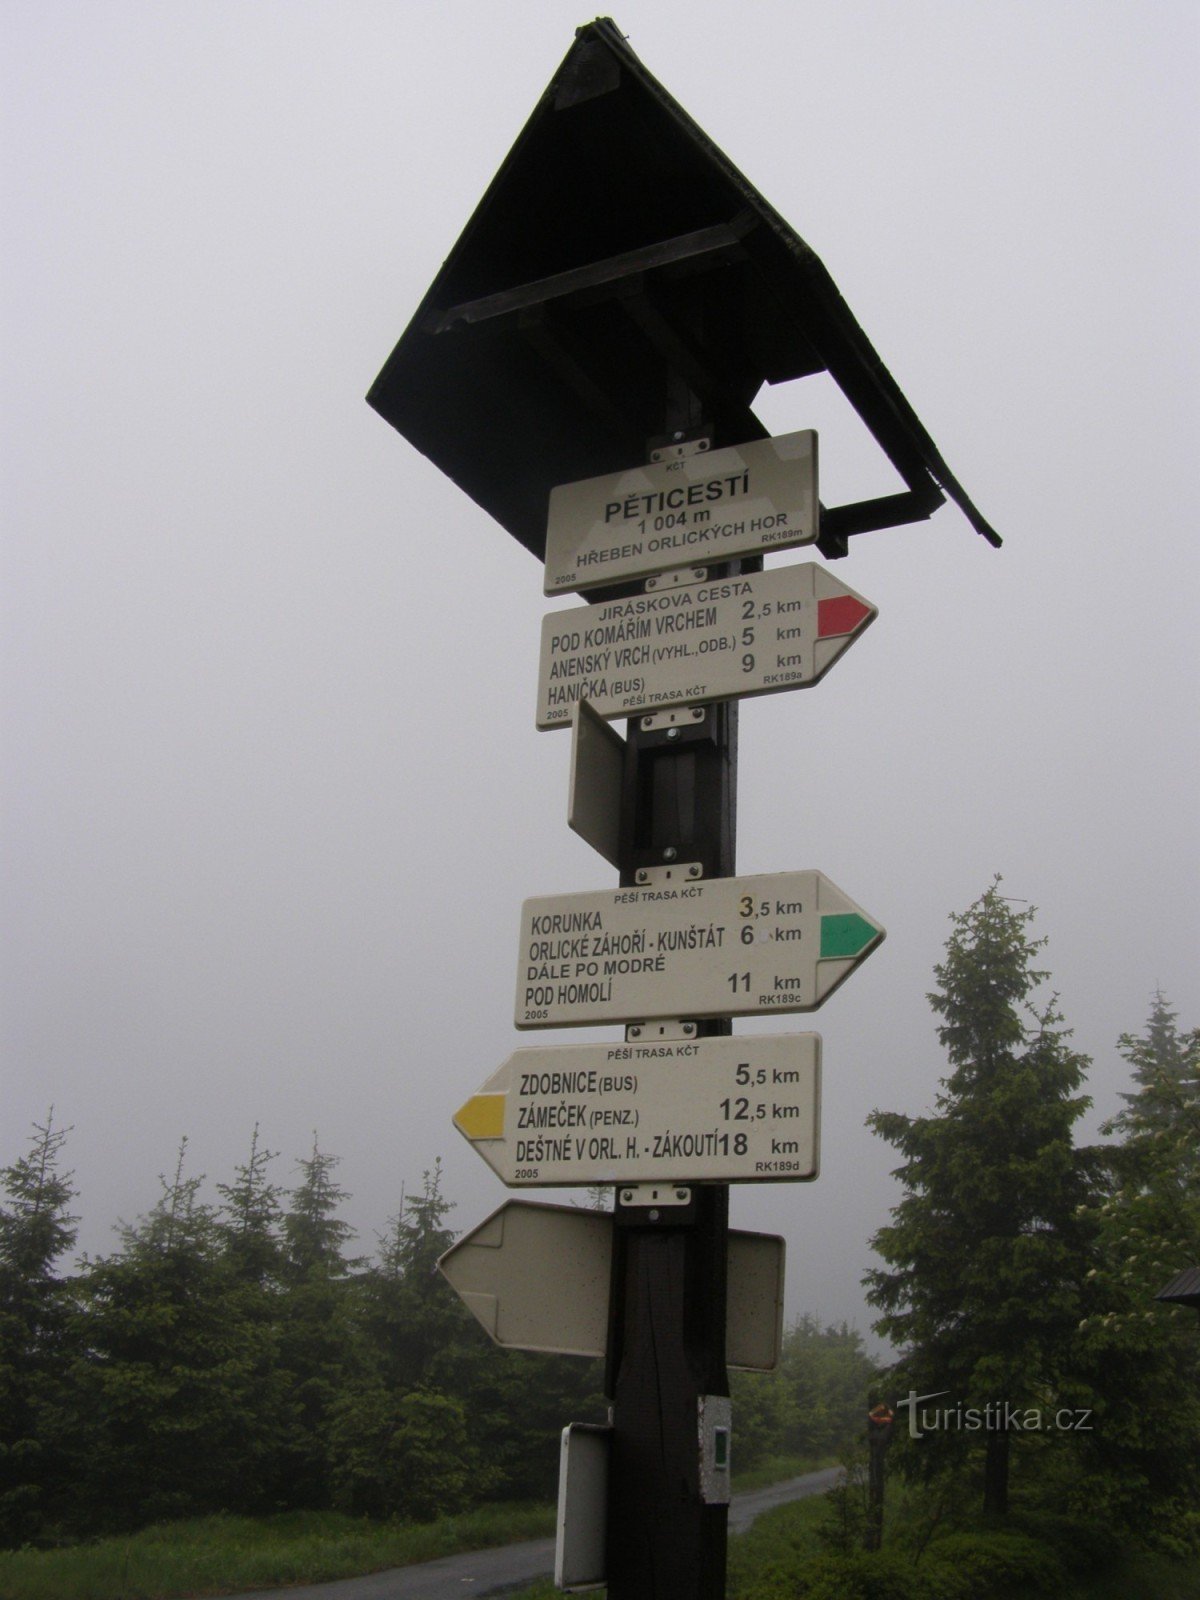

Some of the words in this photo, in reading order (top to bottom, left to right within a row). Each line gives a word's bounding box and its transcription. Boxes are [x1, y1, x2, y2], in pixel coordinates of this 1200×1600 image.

[666, 461, 686, 473] KČT
[604, 468, 750, 523] PĚTICESTÍ
[693, 509, 711, 524] m
[576, 542, 643, 568] HŘEBEN
[648, 521, 745, 552] ORLICKÝCH
[750, 513, 788, 533] HOR
[761, 529, 803, 544] RK189m
[555, 573, 577, 585] 2005
[598, 591, 693, 621] JIRÁSKOVA
[697, 581, 753, 602] CESTA
[551, 632, 580, 654] POD
[584, 615, 650, 649] KOMÁŘÍM
[655, 606, 718, 635] VRCHEM
[741, 600, 771, 620] 2,5
[777, 599, 801, 614] km
[549, 647, 611, 680] ANENSKÝ
[614, 645, 650, 669] VRCH
[741, 627, 755, 646] 5
[777, 626, 801, 641] km
[548, 677, 607, 706] HANIČKA
[610, 677, 645, 698] (BUS)
[742, 653, 755, 673] 9
[777, 653, 801, 668] km
[763, 671, 802, 685] RK189a
[649, 690, 682, 703] TRASA
[686, 685, 707, 697] KČT
[546, 708, 569, 720] 2005
[641, 890, 678, 902] TRASA
[681, 887, 704, 899] KČT
[531, 911, 602, 935] KORUNKA
[739, 896, 770, 920] 3,5
[775, 900, 802, 915] km
[529, 933, 589, 962] ORLICKÉ
[592, 929, 646, 957] ZÁHOŘÍ
[657, 923, 725, 952] KUNŠTÁT
[740, 925, 754, 945] 6
[775, 927, 802, 941] km
[527, 960, 571, 981] DÁLE
[575, 962, 599, 976] PO
[603, 953, 666, 975] MODRÉ
[525, 986, 553, 1007] POD
[557, 978, 612, 1005] HOMOLÍ
[727, 972, 752, 993] 11
[774, 976, 801, 990] km
[759, 993, 801, 1006] RK189c
[524, 1009, 549, 1020] 2005
[636, 1047, 673, 1059] TRASA
[676, 1044, 700, 1056] KČT
[519, 1070, 597, 1096] ZDOBNICE
[599, 1075, 639, 1096] (BUS)
[735, 1063, 766, 1087] 5,5
[772, 1069, 800, 1084] km
[517, 1101, 586, 1129] ZÁMEČEK
[589, 1109, 640, 1130] (PENZ.)
[719, 1097, 766, 1122] 12,5
[772, 1104, 800, 1119] km
[516, 1135, 571, 1162] DEŠTNÉ
[576, 1138, 586, 1160] V
[588, 1137, 622, 1160] ORL.
[625, 1137, 640, 1159] H.
[652, 1128, 719, 1158] ZÁKOUTÍ
[719, 1133, 749, 1156] 18
[771, 1138, 799, 1153] km
[515, 1168, 539, 1179] 2005
[755, 1161, 800, 1172] RK189d
